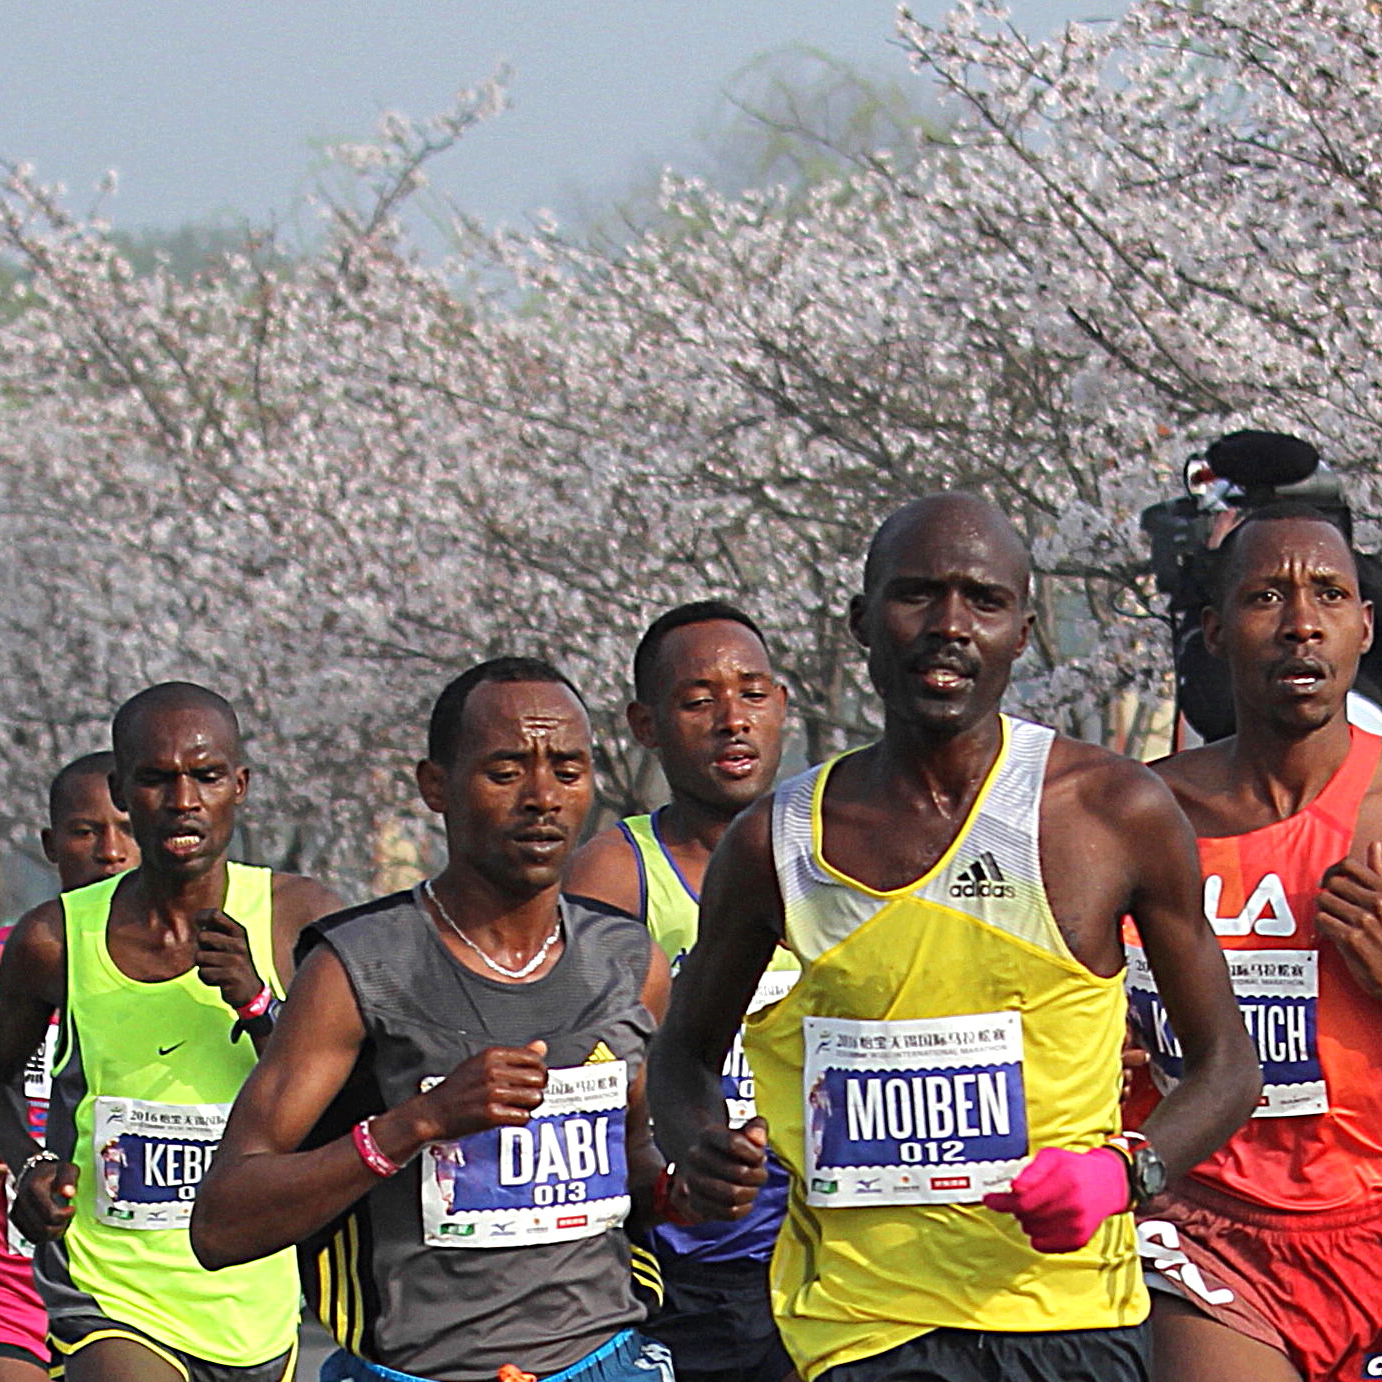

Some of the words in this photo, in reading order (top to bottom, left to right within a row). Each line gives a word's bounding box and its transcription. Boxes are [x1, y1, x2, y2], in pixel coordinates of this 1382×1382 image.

[950, 881, 1016, 898] adidas
[846, 1071, 1010, 1141] MOIBEN
[500, 1116, 610, 1186] DABI
[900, 1140, 966, 1162] 012
[533, 1181, 586, 1205] 013
